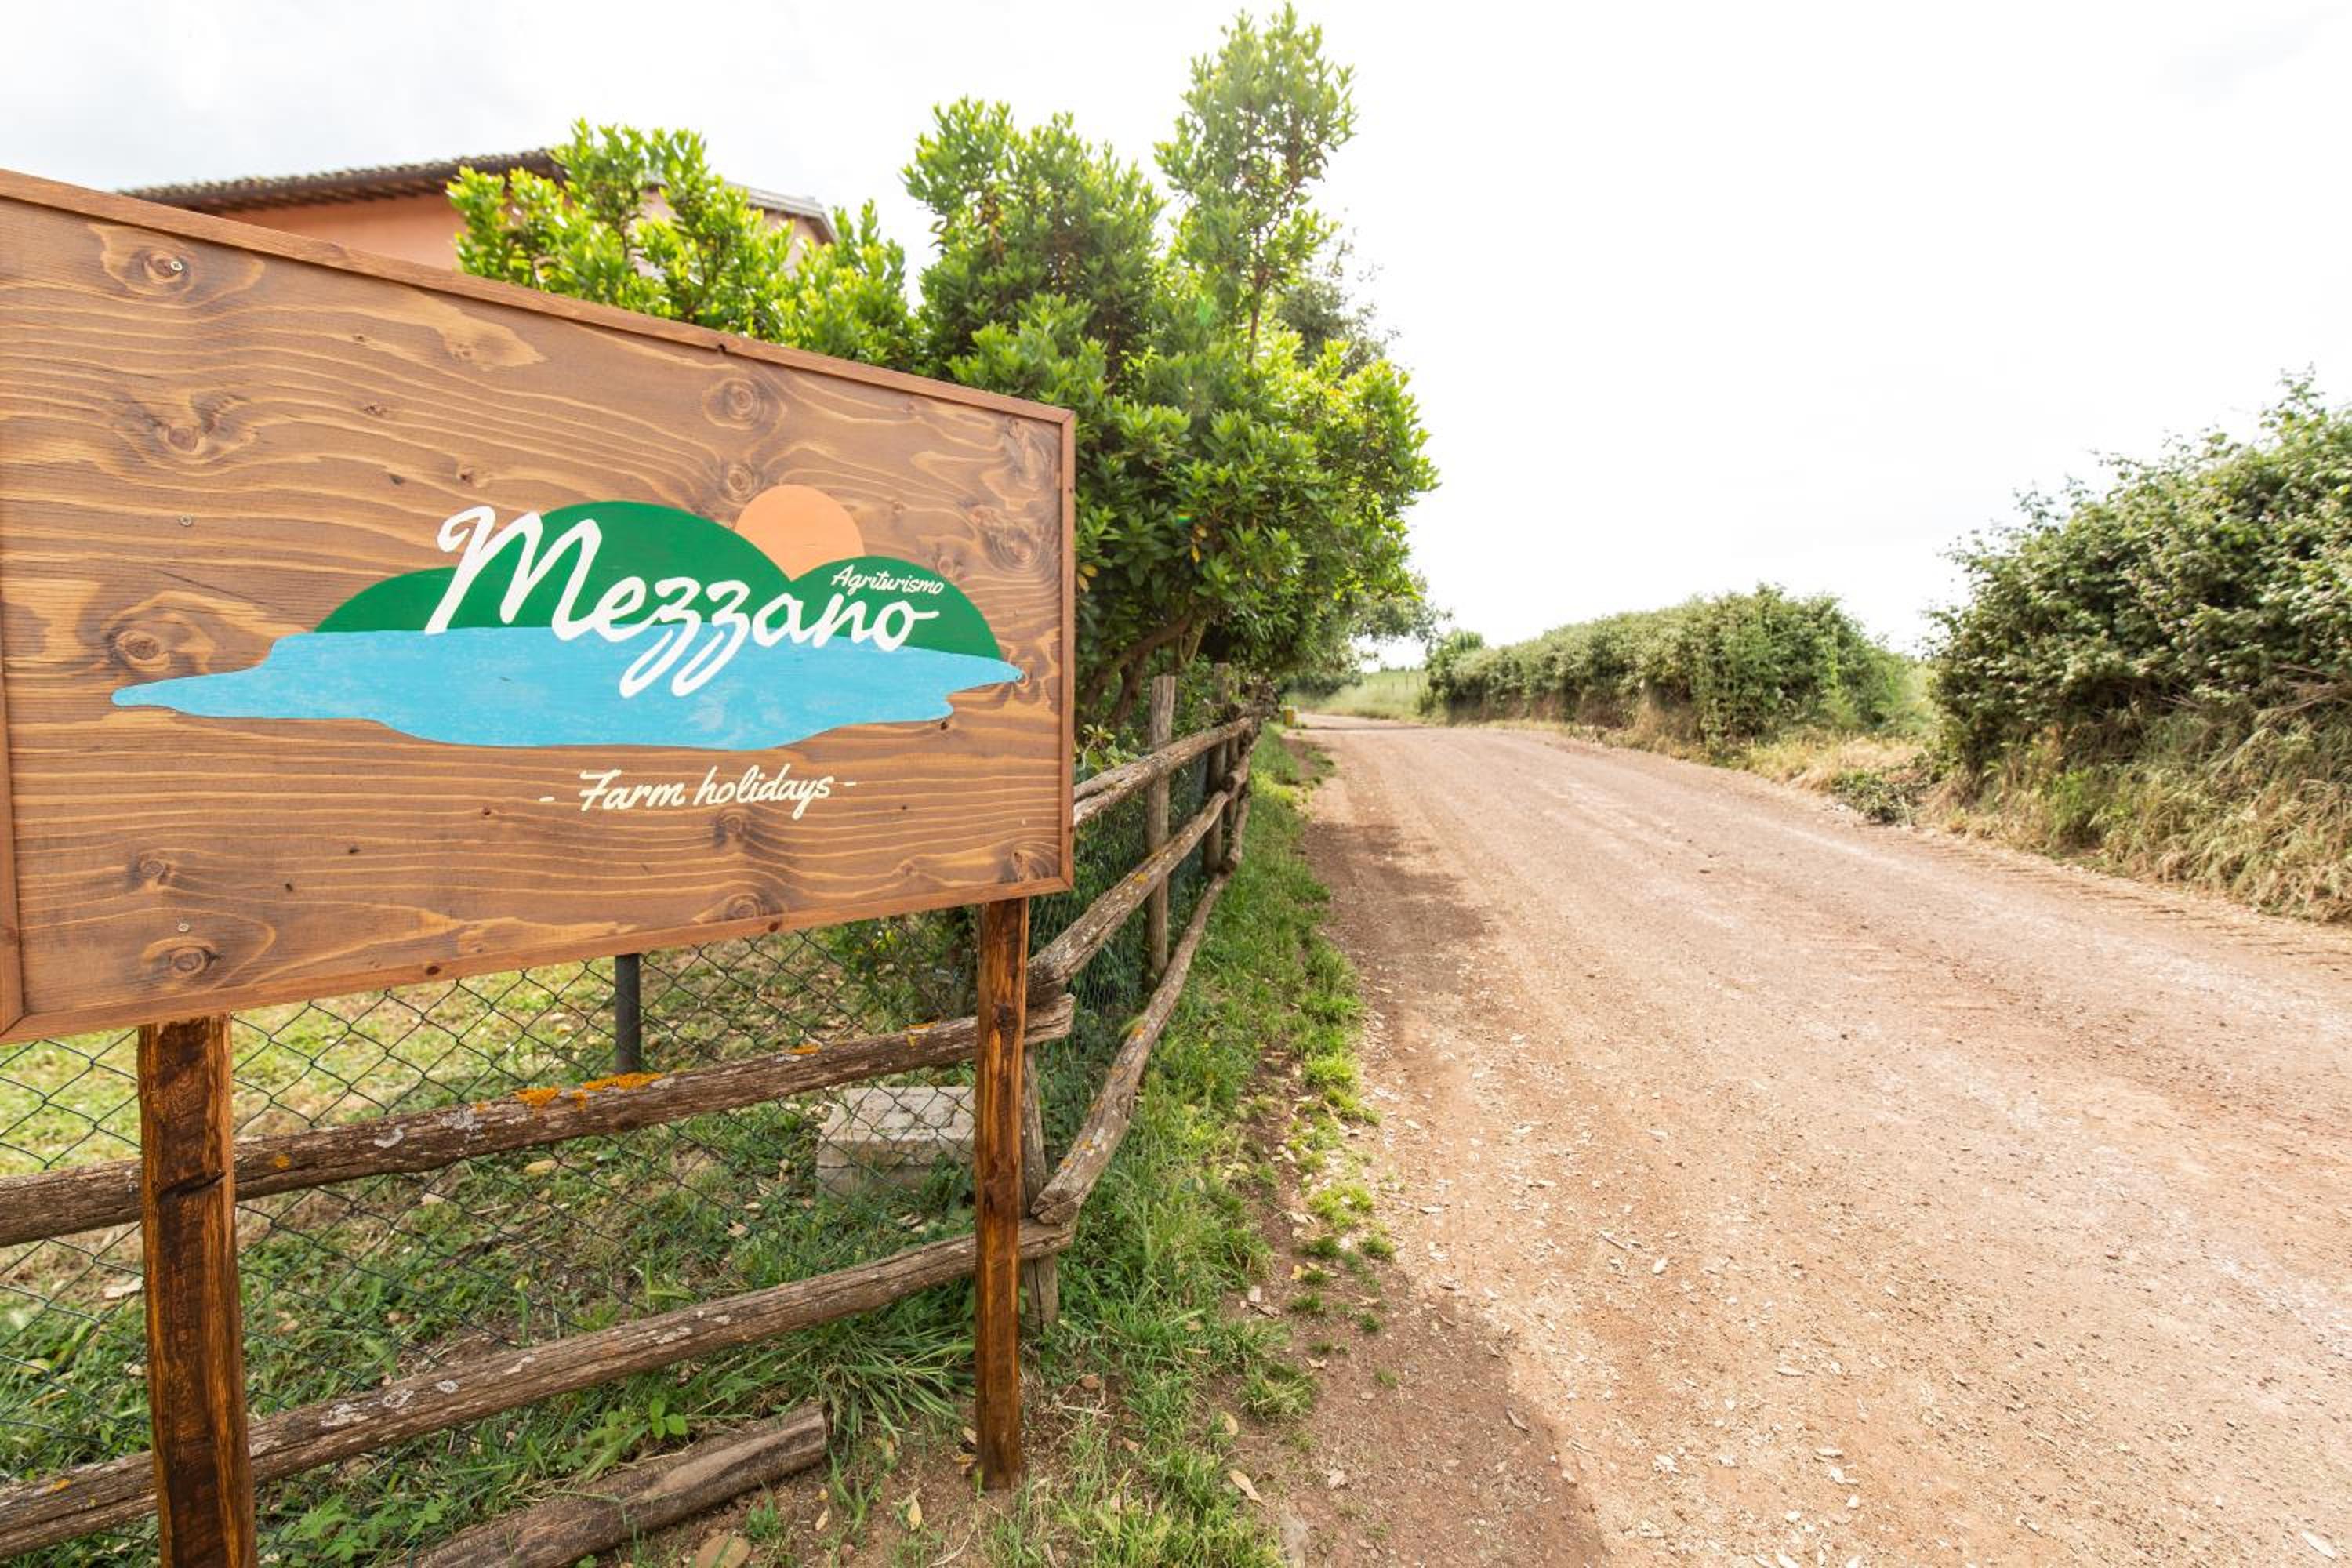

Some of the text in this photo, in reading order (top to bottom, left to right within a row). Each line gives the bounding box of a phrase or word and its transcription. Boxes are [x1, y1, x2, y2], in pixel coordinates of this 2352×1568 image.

[424, 506, 939, 697] Mezzano
[831, 564, 945, 595] Agriturismo
[579, 769, 686, 811] Farm
[694, 763, 834, 820] holidays
